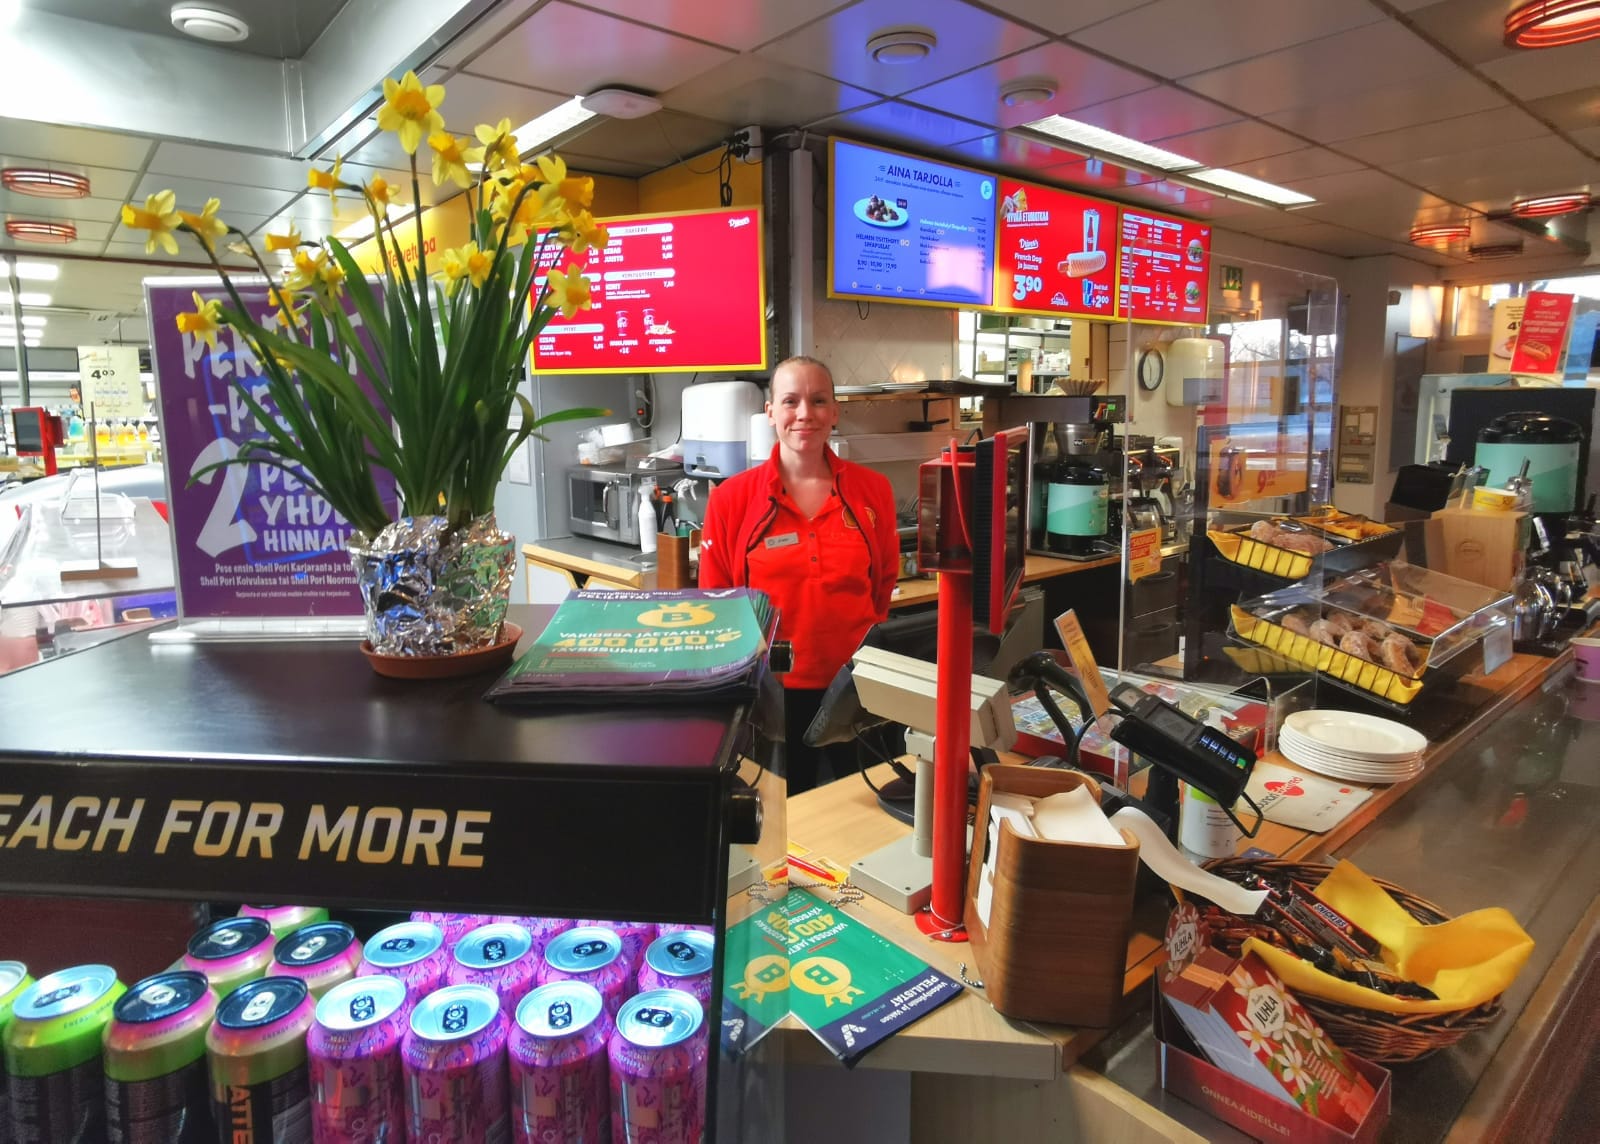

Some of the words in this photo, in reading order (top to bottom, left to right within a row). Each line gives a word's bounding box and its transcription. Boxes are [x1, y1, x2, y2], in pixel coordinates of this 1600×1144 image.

[887, 165, 911, 179] AINA
[913, 170, 953, 188] TARJOLLA
[1014, 252, 1031, 262] French
[1031, 256, 1043, 264] Dog
[189, 437, 258, 558] 2
[215, 563, 232, 573] Pese
[234, 563, 254, 572] ensin
[255, 563, 273, 572] Shell
[274, 563, 290, 572] Pori
[291, 563, 332, 573] Karjaranta
[334, 563, 342, 573] ja
[200, 575, 219, 586] Shell
[220, 576, 235, 586] Pori
[237, 576, 277, 586] Koivulassa
[279, 576, 289, 585] tai
[290, 576, 308, 585] Shell
[310, 576, 326, 585] Pori
[552, 637, 628, 647] 400
[634, 635, 708, 647] 000
[637, 629, 700, 638] JAETAAN
[704, 627, 733, 635] NYT
[663, 643, 726, 652] KESKEN
[154, 799, 285, 859] FOR
[297, 803, 492, 867] MORE
[1315, 903, 1347, 928] SNICKERS
[1174, 932, 1193, 954] JUHLA
[890, 975, 939, 1007] PELILISTAT
[1255, 995, 1279, 1028] JUHLA
[1200, 1084, 1239, 1109] ONNEA
